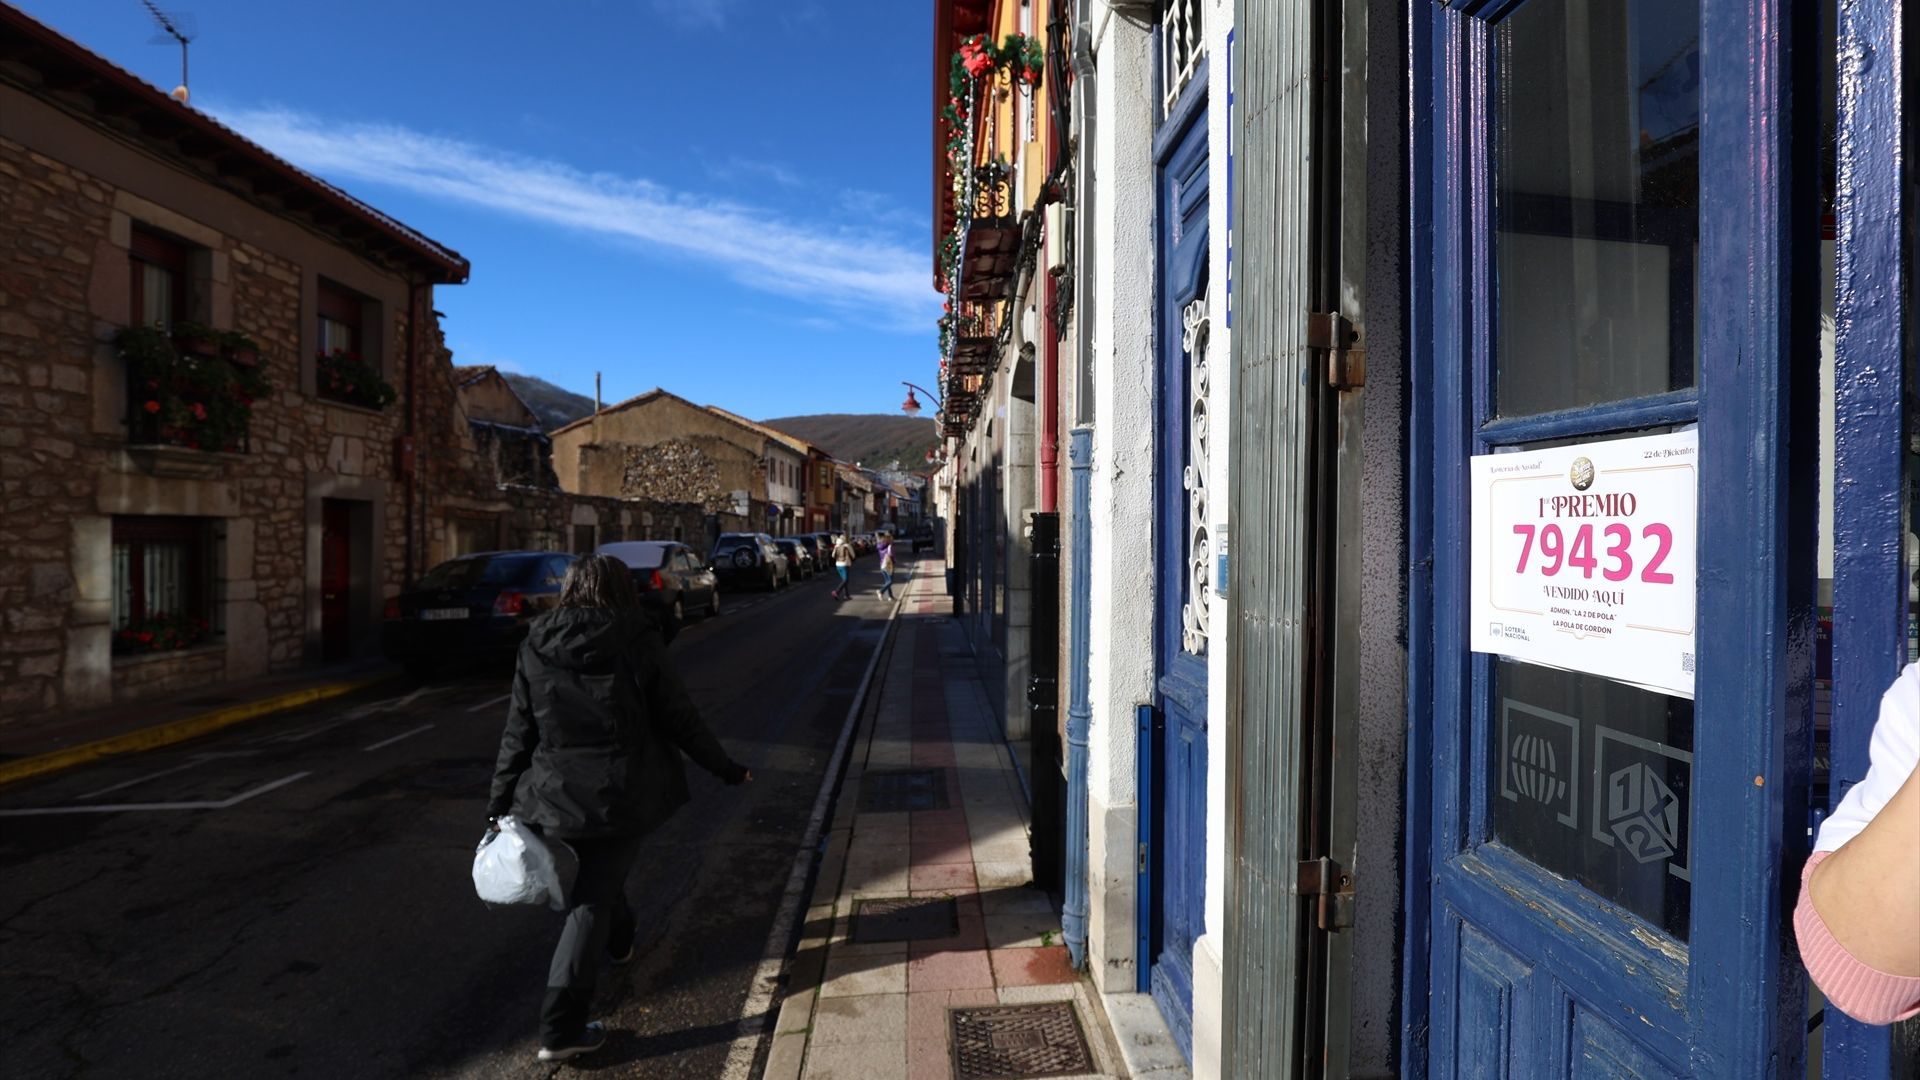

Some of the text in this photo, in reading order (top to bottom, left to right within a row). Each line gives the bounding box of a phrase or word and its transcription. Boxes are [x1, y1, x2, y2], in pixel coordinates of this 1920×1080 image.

[1653, 450, 1662, 458] de
[1551, 492, 1637, 518] PREMIO
[1513, 523, 1674, 585] 79432
[1543, 585, 1625, 607] VENDIDO AQUÍ
[1583, 610, 1587, 618] 2
[1587, 611, 1596, 619] DE
[1560, 620, 1575, 629] POLA
[1575, 623, 1584, 631] DE
[1504, 632, 1531, 642] NACIONAL
